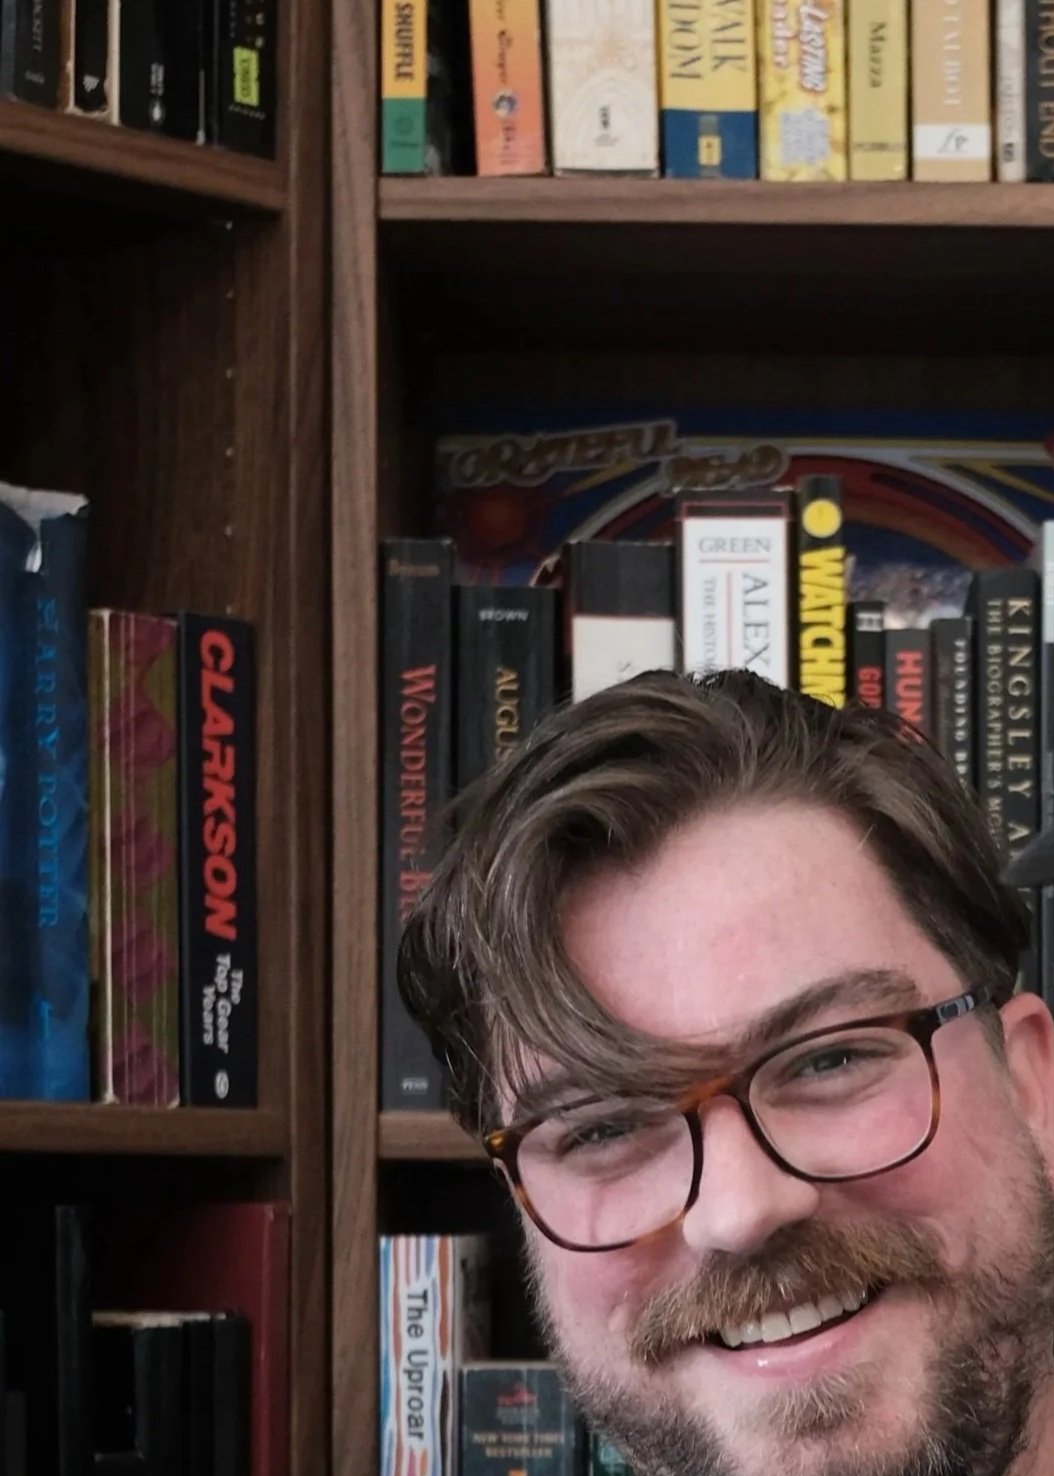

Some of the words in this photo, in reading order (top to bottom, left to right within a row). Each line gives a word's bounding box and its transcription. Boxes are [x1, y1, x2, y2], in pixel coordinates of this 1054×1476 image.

[394, 3, 415, 82] SHUFFLE
[869, 22, 888, 88] Mazza
[698, 537, 771, 554] GREEN
[479, 608, 529, 622] BROWN
[986, 598, 1003, 634] THE
[1007, 597, 1034, 798] KINGSLEY
[201, 629, 237, 941] CLARKSON
[36, 772, 59, 930] POTTER
[214, 953, 231, 993] Top
[230, 969, 244, 1005] The
[202, 984, 217, 1046] Years
[217, 998, 231, 1055] Gear
[407, 1289, 428, 1339] The
[403, 1350, 429, 1443] Uproar
